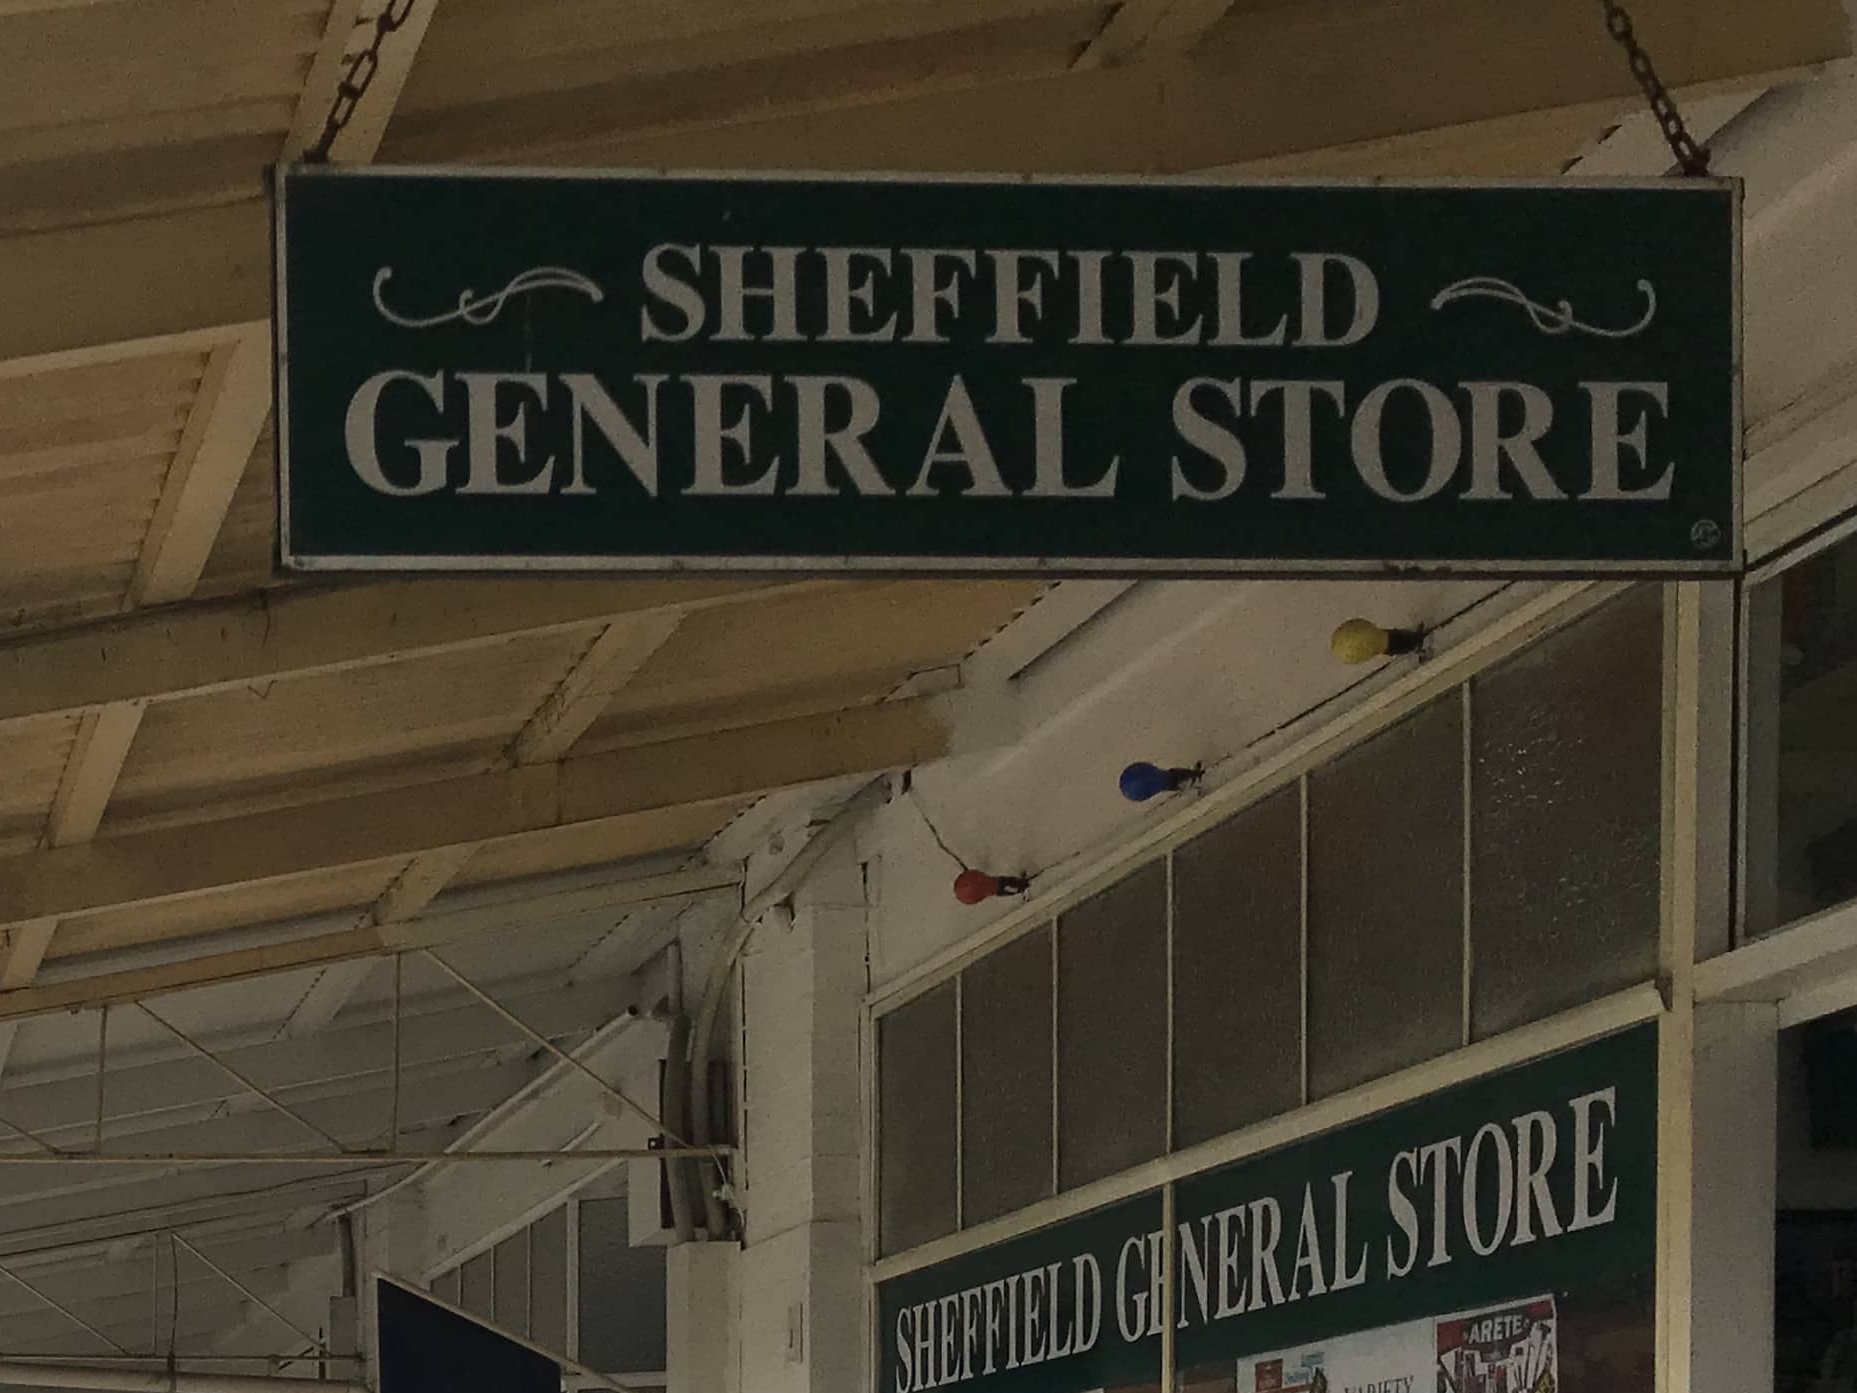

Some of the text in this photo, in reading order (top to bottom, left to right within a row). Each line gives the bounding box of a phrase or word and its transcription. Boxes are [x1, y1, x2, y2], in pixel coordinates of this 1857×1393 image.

[641, 242, 1381, 347] SHEFFIELD
[344, 368, 1676, 503] GENERAL STORE
[1115, 1170, 1369, 1343] GENERAL
[1386, 1085, 1619, 1281] STORE
[1467, 1314, 1522, 1345] ARETE
